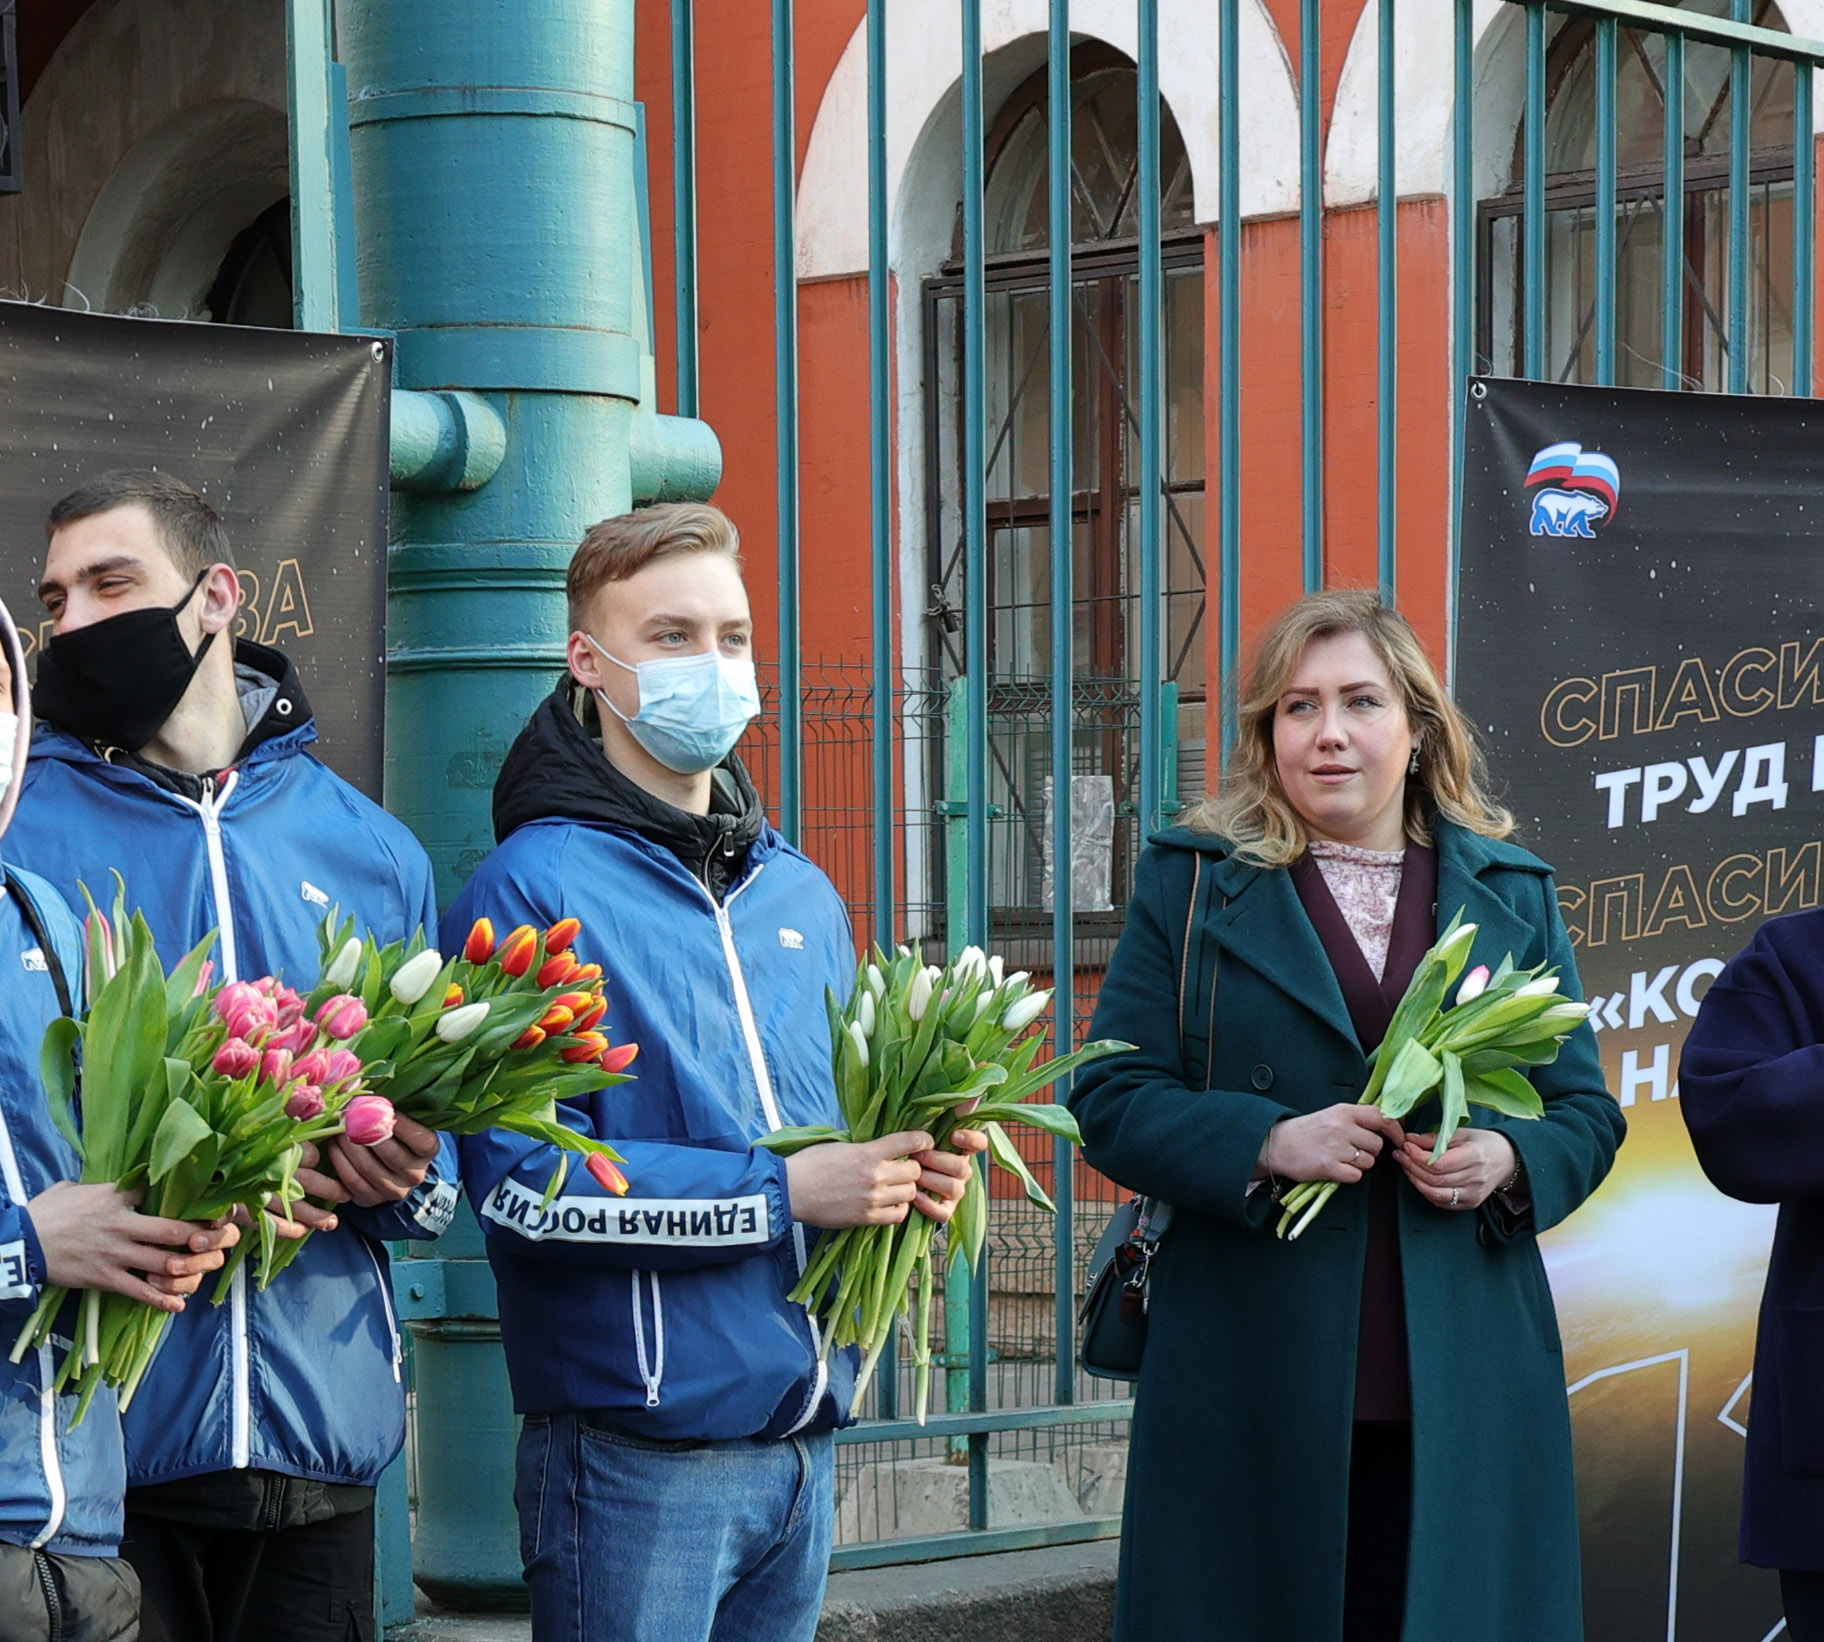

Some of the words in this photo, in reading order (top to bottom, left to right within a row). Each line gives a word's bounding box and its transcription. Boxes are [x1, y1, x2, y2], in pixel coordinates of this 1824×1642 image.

[1595, 741, 1788, 829] ТРУД
[1588, 957, 1727, 1034] «КО
[1619, 1044, 1679, 1108] Н
[618, 1202, 757, 1236] ЕДИНАЯ
